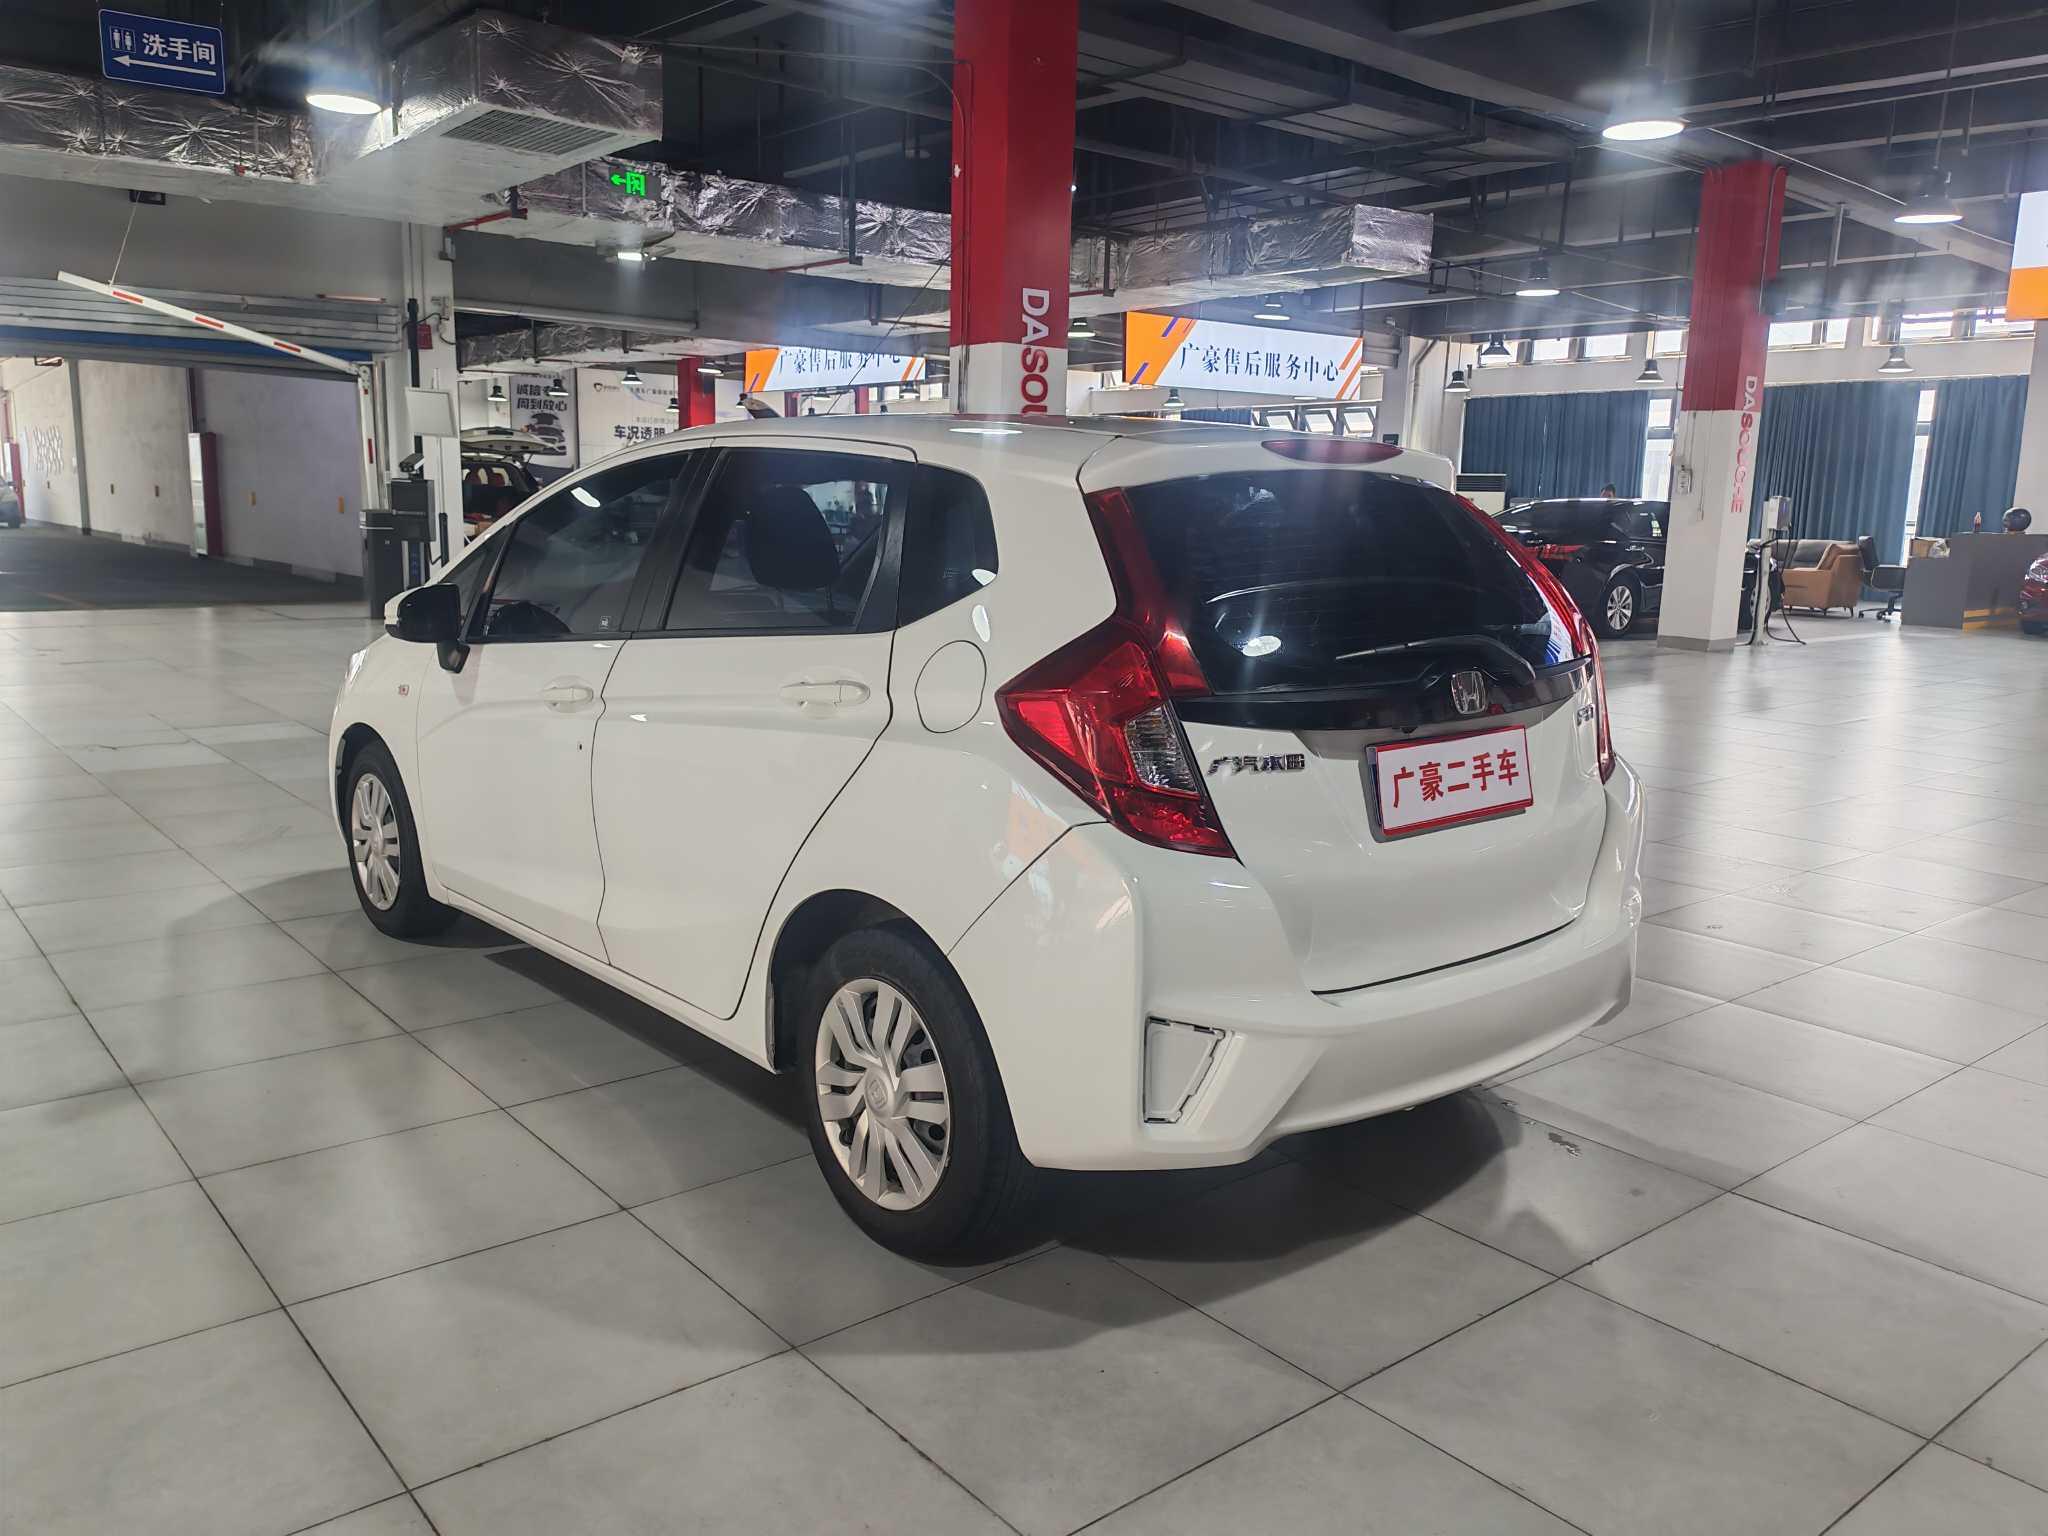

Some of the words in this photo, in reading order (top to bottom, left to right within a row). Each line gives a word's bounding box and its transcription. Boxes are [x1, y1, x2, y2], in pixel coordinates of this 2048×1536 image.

[142, 32, 216, 65] 洗手间
[1179, 342, 1339, 383] 广豪售后服务中心
[516, 398, 568, 412] 周到放心
[614, 424, 666, 440] 车况透明
[1207, 753, 1305, 776] 广汽本田
[1393, 748, 1520, 809] 广豪二手车
